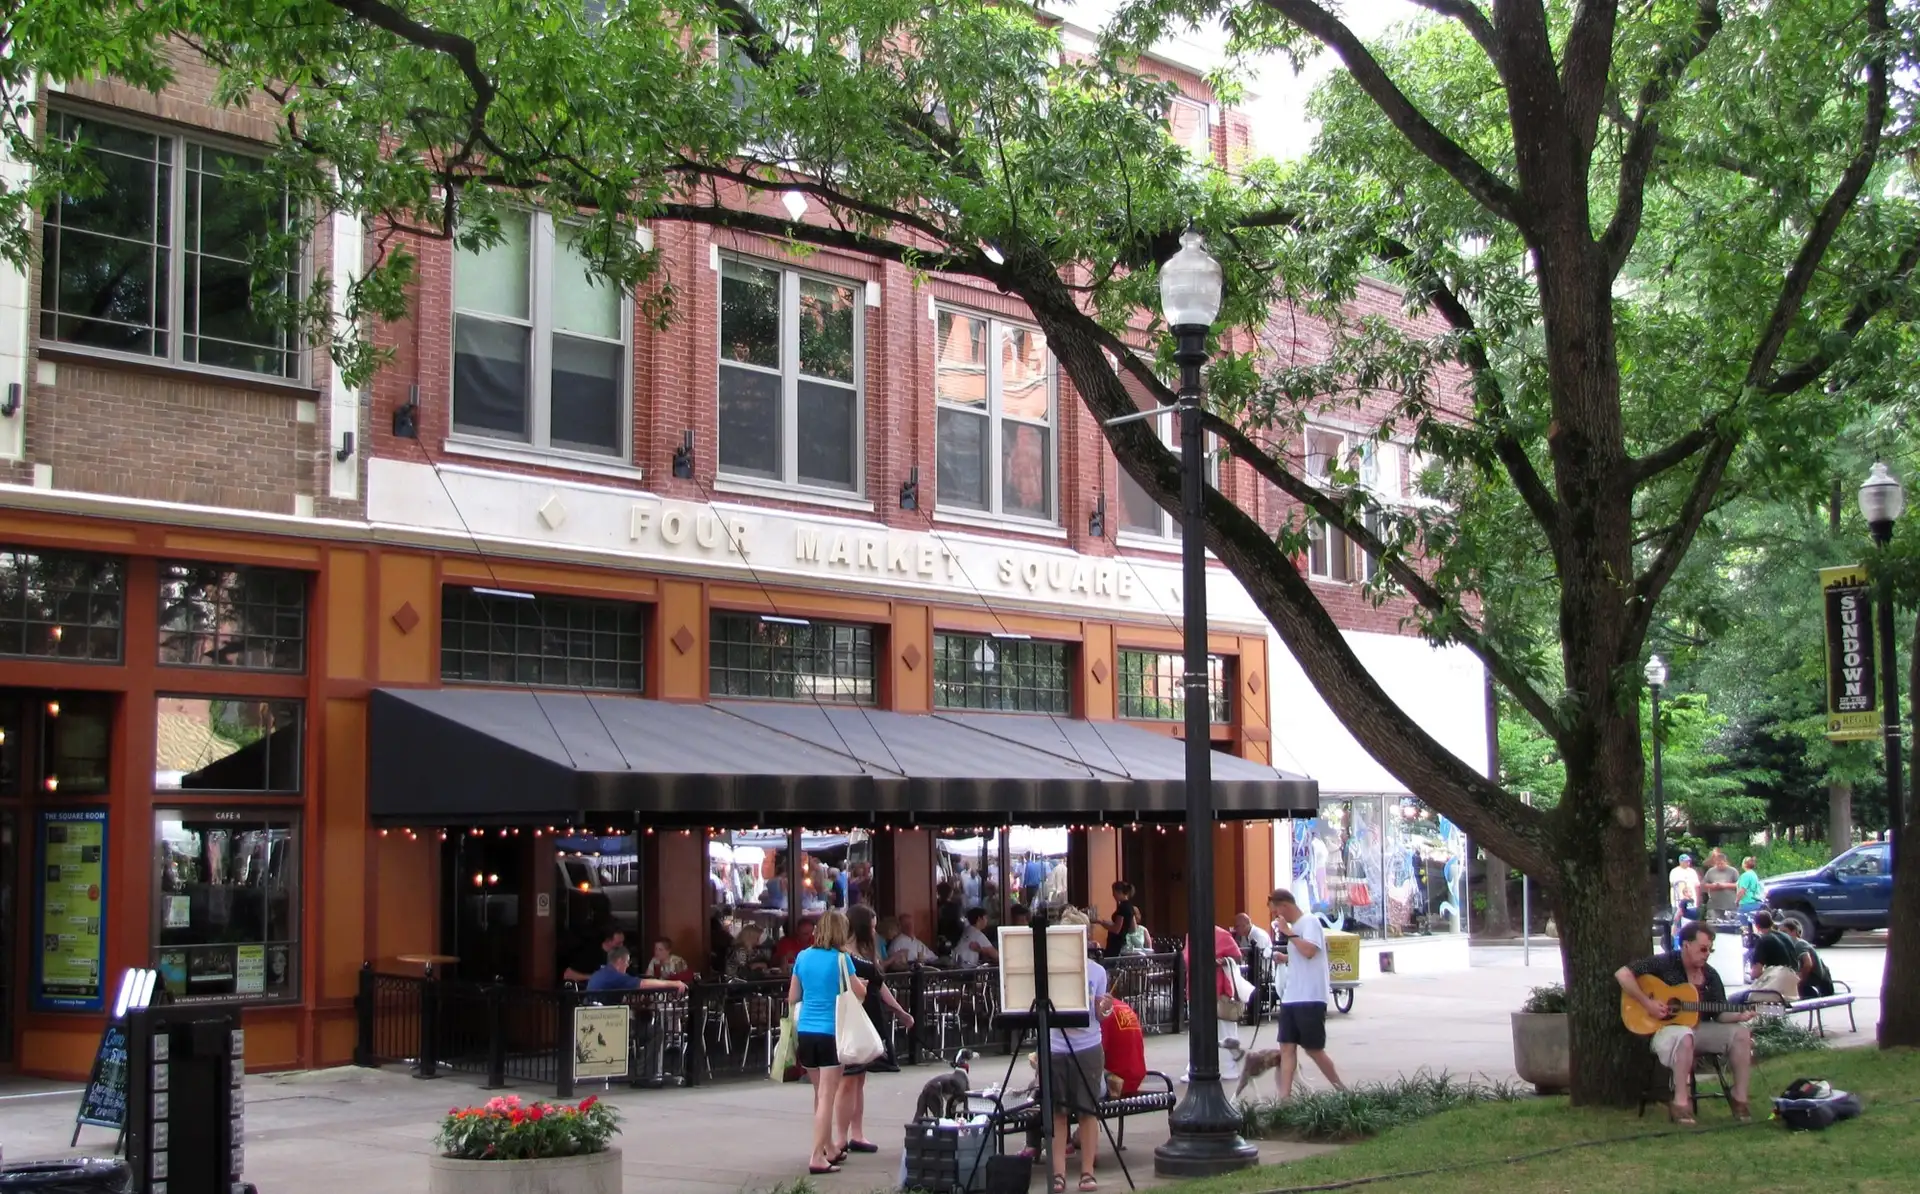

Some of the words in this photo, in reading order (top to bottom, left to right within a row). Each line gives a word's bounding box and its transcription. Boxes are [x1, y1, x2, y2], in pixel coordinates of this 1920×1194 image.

[629, 505, 752, 554] FOUR
[796, 526, 959, 579] MARKET
[997, 552, 1135, 599] SQUARE
[1840, 596, 1862, 695] SUNDOWN
[1839, 702, 1867, 710] CITY
[45, 812, 57, 820] THE
[59, 812, 84, 820] SQUARE
[85, 812, 105, 820] ROOM
